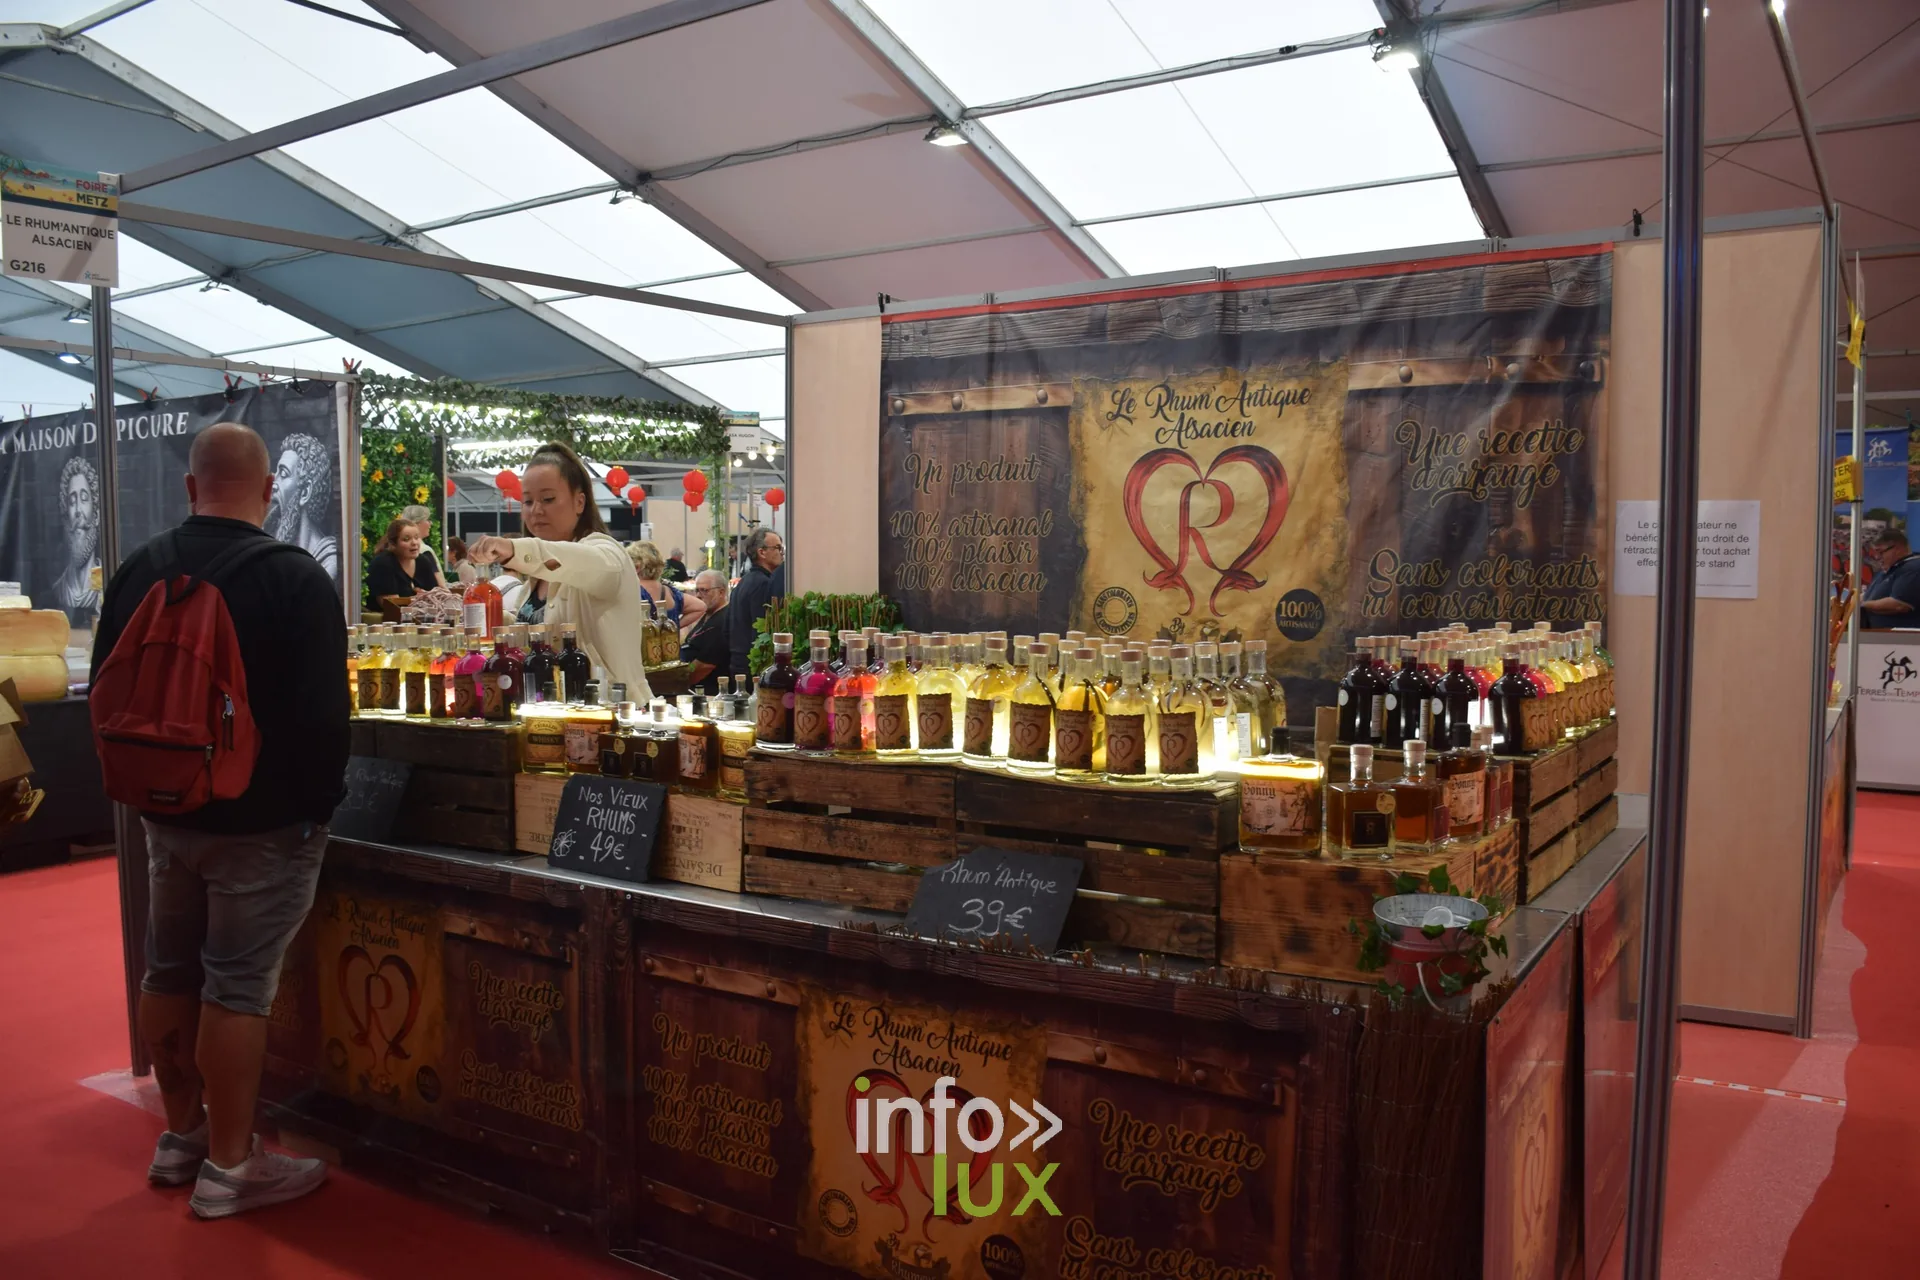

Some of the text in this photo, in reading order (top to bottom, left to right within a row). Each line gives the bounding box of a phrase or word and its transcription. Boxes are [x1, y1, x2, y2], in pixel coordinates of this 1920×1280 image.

[76, 192, 108, 207] METZ
[6, 214, 21, 226] LE
[32, 234, 92, 251] ALSACIEN
[10, 259, 46, 274] G216
[1106, 387, 1137, 426] Le
[13, 424, 76, 454] MAISON
[1155, 412, 1256, 449] Alsacien
[1394, 419, 1586, 468] Une recette
[903, 452, 1041, 497] Un produit
[889, 509, 1054, 538] 100% artisanal
[1638, 520, 1649, 529] Le
[1724, 522, 1737, 530] ne
[1713, 534, 1734, 543] droit
[1737, 534, 1749, 543] de
[903, 537, 1039, 572] 100% plaisir
[1702, 547, 1721, 556] tout
[1723, 547, 1751, 556] achat
[1709, 559, 1735, 568] stand
[895, 564, 1047, 593] 100% alsacien
[1367, 548, 1605, 598] Sans colorants
[1279, 600, 1322, 621] 100%
[1360, 586, 1607, 621] ni conservateurs
[579, 785, 603, 805] Nos
[586, 806, 637, 835] RHUMS
[590, 831, 625, 862] 49€
[948, 898, 1032, 937] 39€
[829, 1001, 857, 1039] Le
[653, 1013, 772, 1071] Un produit
[872, 1039, 963, 1078] Alsacien
[504, 1069, 579, 1107] colorants
[642, 1064, 784, 1127] 100% artisanal
[654, 1094, 771, 1149] 100% plaisir
[1089, 1098, 1266, 1169] Une recette
[647, 1116, 779, 1178] 100% alsacien
[1064, 1215, 1141, 1267] Sans
